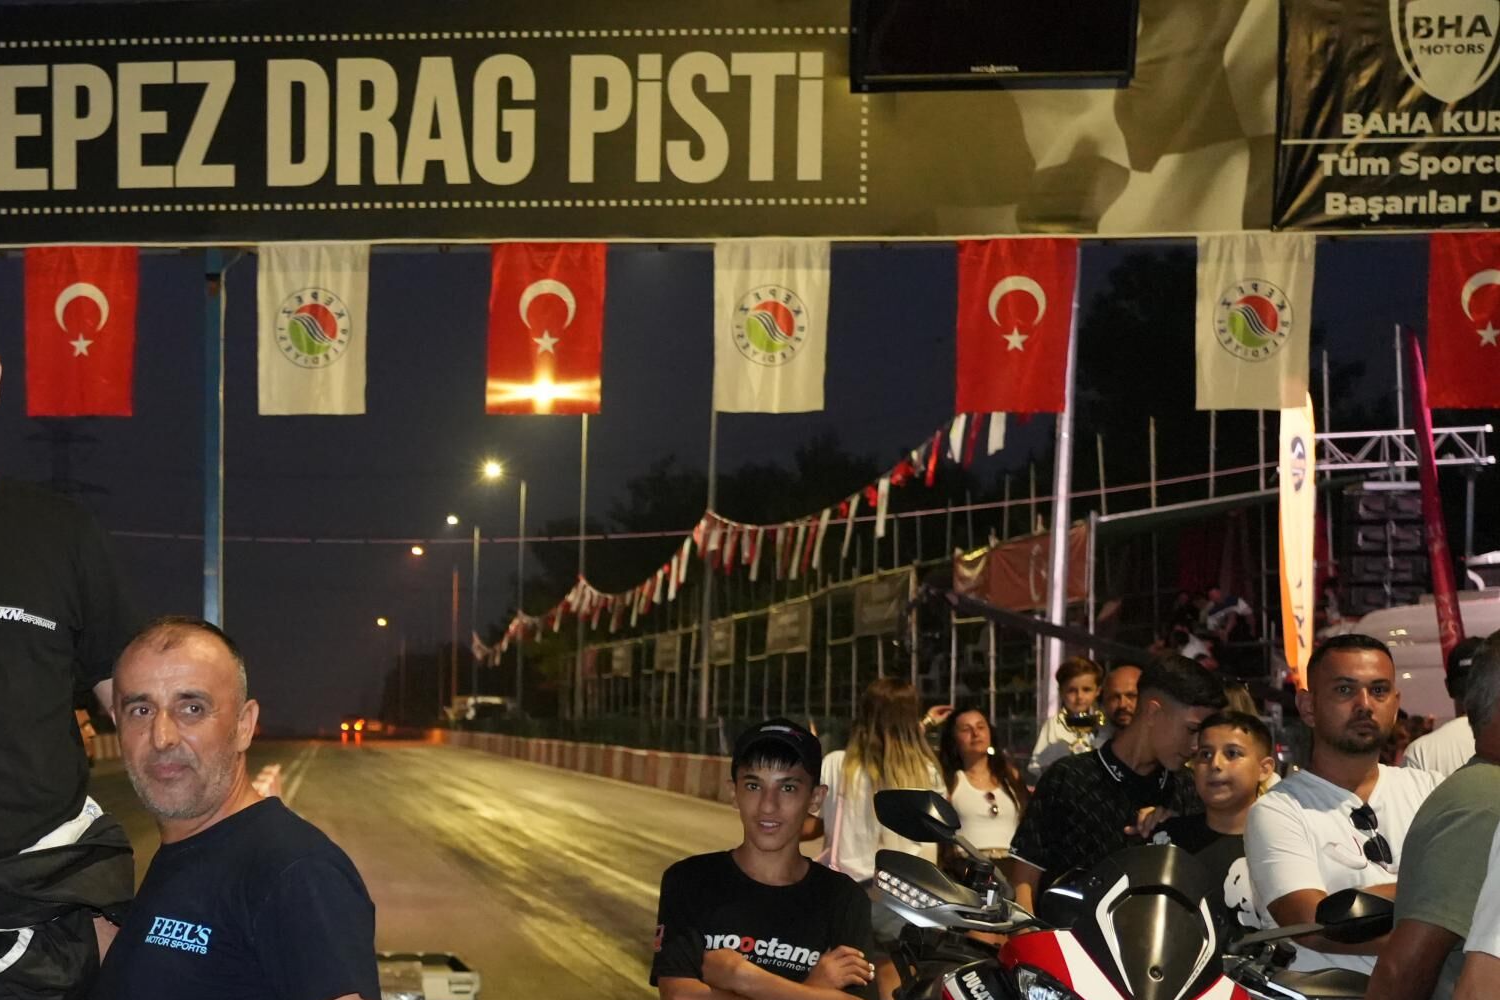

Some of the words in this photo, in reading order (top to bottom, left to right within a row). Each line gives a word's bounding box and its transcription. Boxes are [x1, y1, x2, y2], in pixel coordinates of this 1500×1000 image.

[1412, 15, 1492, 38] BHA
[1420, 44, 1485, 55] MOTORS
[266, 54, 536, 188] DRAG
[1342, 111, 1433, 135] BAHA
[1318, 149, 1390, 176] Tüm
[1325, 190, 1472, 220] Başarılar
[148, 916, 212, 946] FEEL'S
[145, 935, 170, 947] MOTOR
[170, 940, 208, 955] SPORTS
